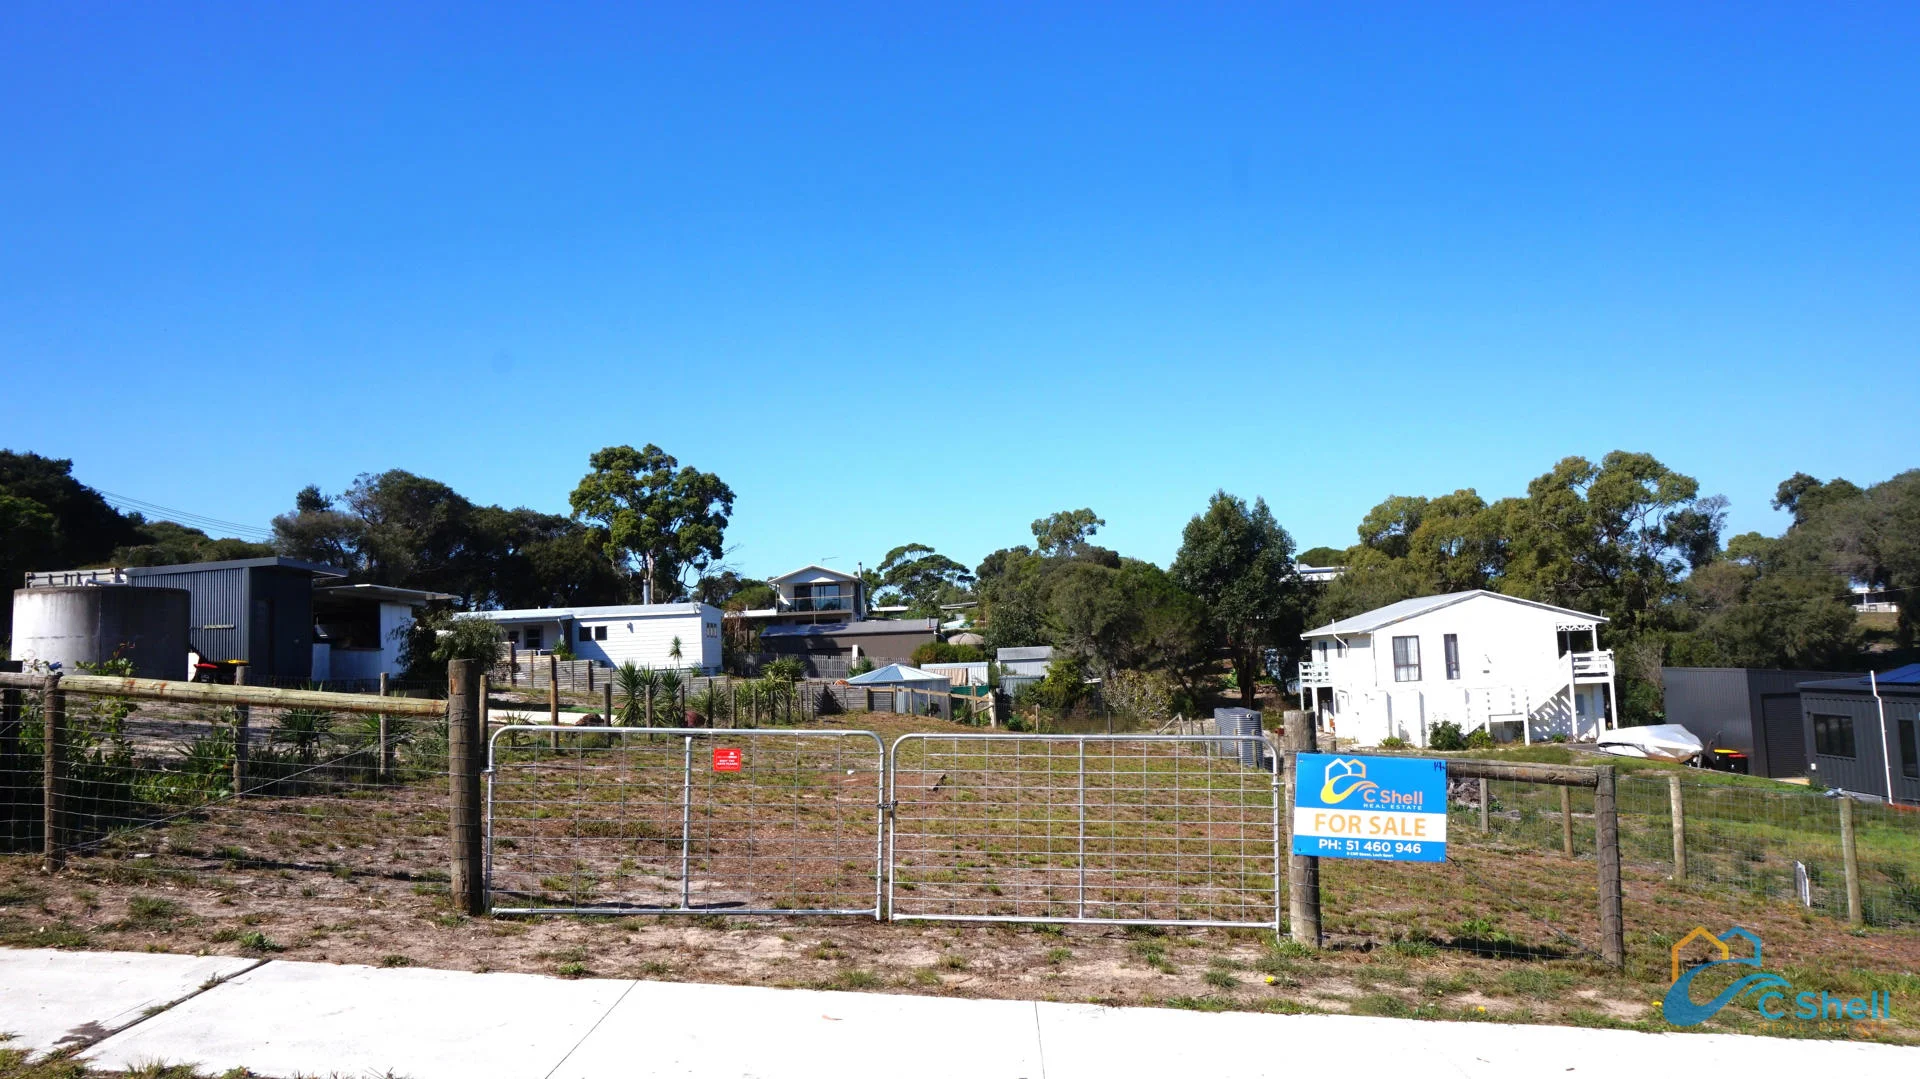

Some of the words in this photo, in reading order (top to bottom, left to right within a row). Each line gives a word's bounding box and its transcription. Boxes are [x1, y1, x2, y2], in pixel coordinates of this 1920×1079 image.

[1363, 789, 1376, 803] C
[1380, 789, 1423, 805] Shell
[1314, 813, 1361, 834] FOR
[1369, 815, 1426, 837] SALE
[1318, 838, 1342, 850] PH:
[1345, 840, 1359, 851] 51
[1363, 841, 1391, 853] 460
[1395, 842, 1422, 854] 946
